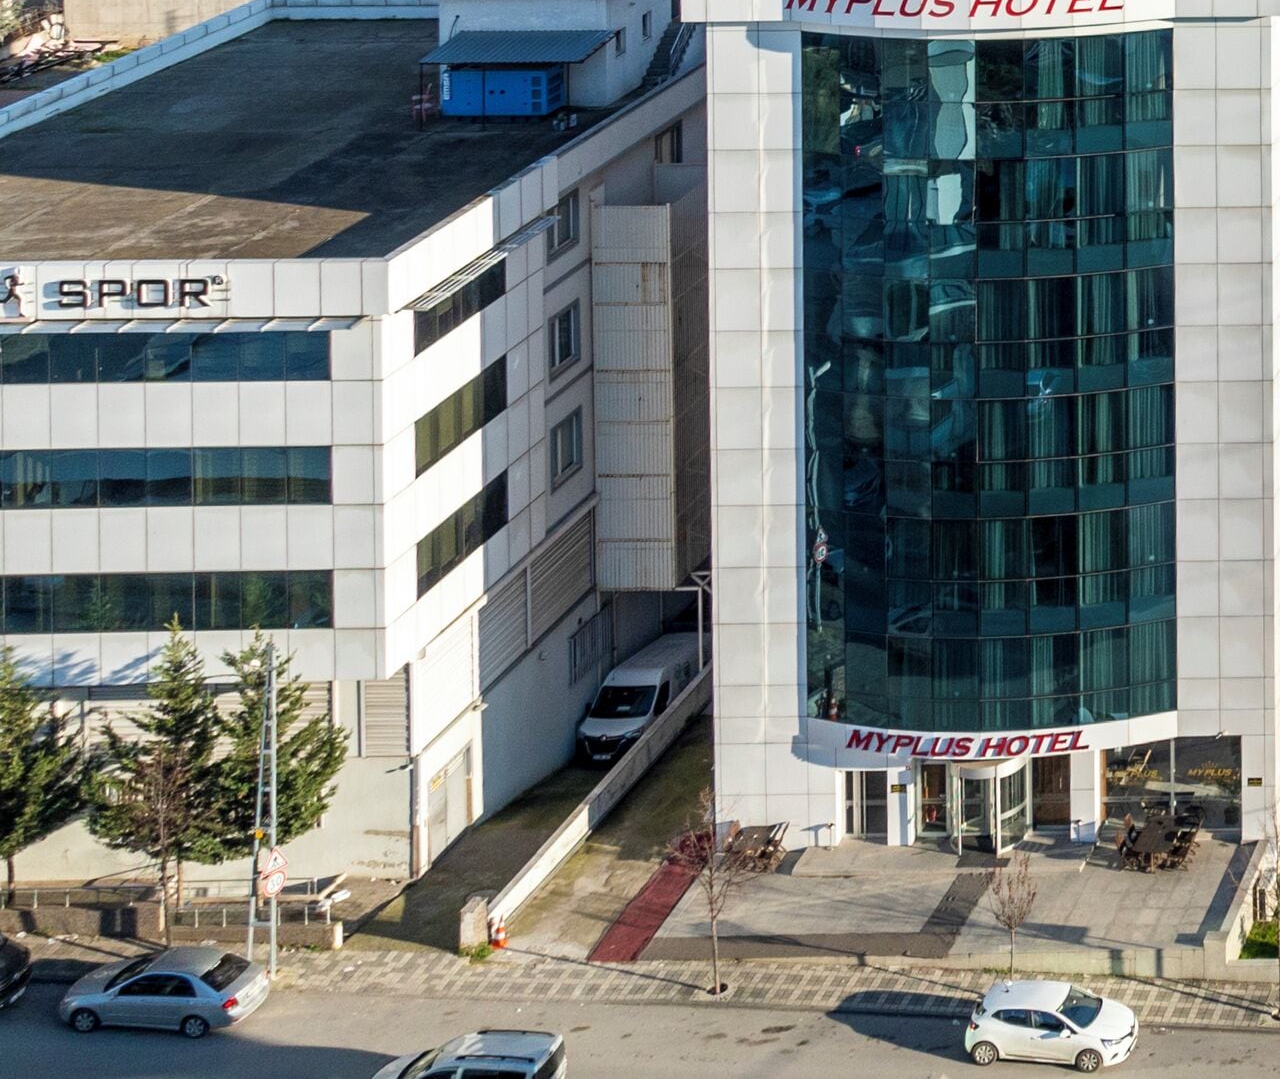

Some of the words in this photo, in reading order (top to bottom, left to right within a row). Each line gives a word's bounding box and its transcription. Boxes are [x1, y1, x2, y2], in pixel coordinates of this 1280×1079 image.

[58, 279, 212, 308] SPOR
[845, 729, 974, 757] MYPLUS
[981, 730, 1090, 757] HOTEL
